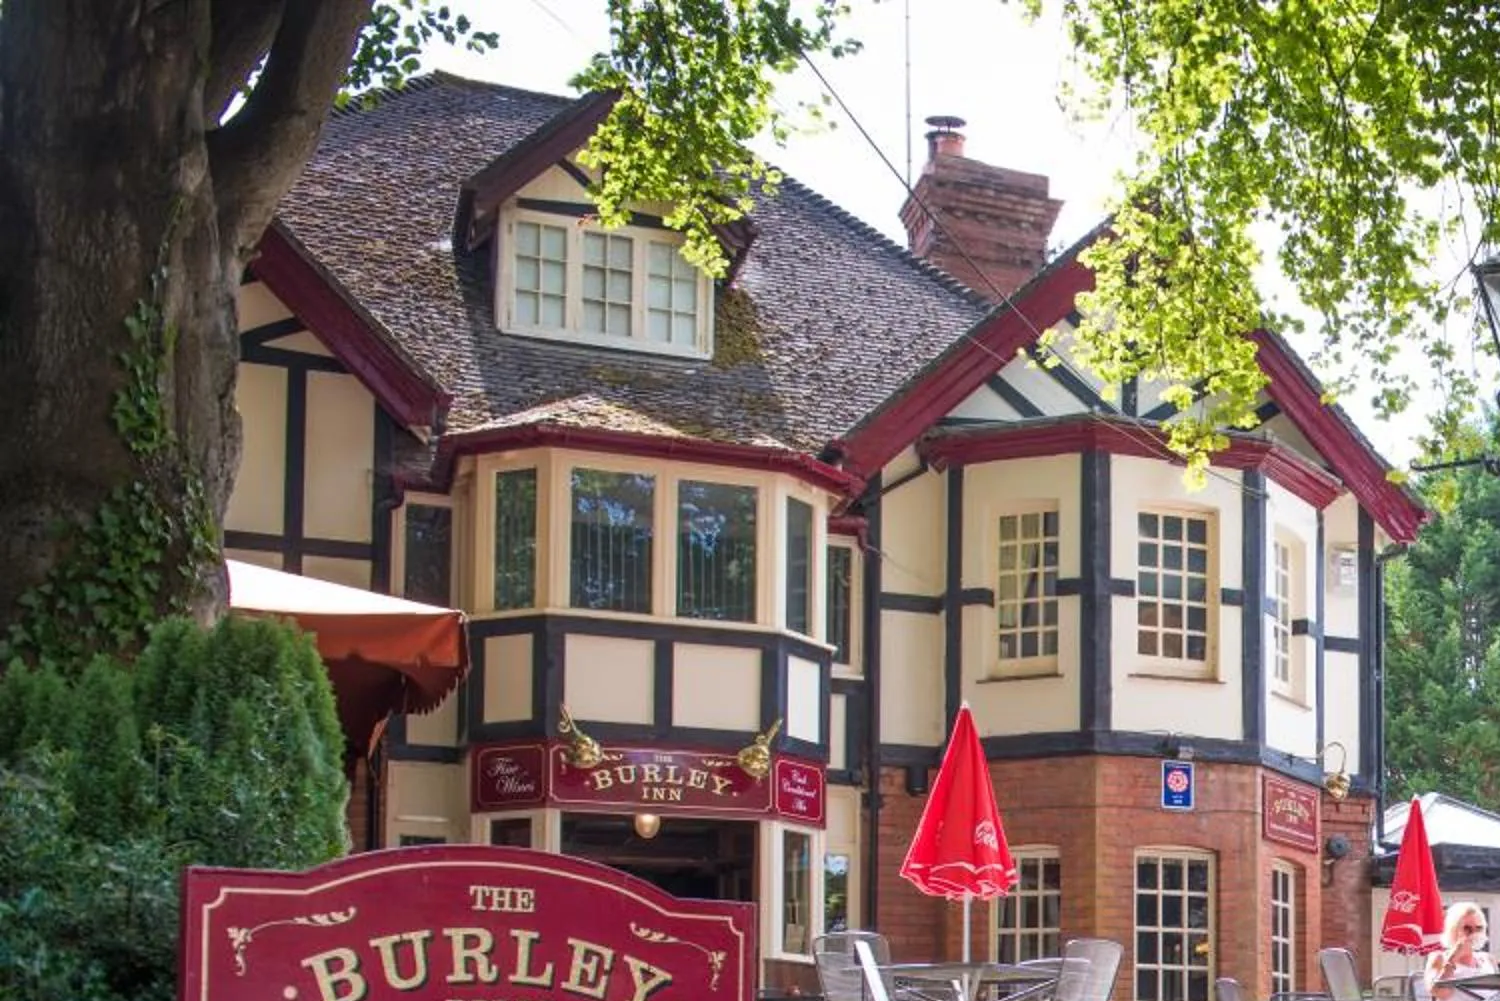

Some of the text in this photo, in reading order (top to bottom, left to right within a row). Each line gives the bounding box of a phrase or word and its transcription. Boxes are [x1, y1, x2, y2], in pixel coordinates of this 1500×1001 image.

[592, 763, 733, 796] BURLEY
[642, 787, 682, 801] INN
[470, 885, 536, 913] THE
